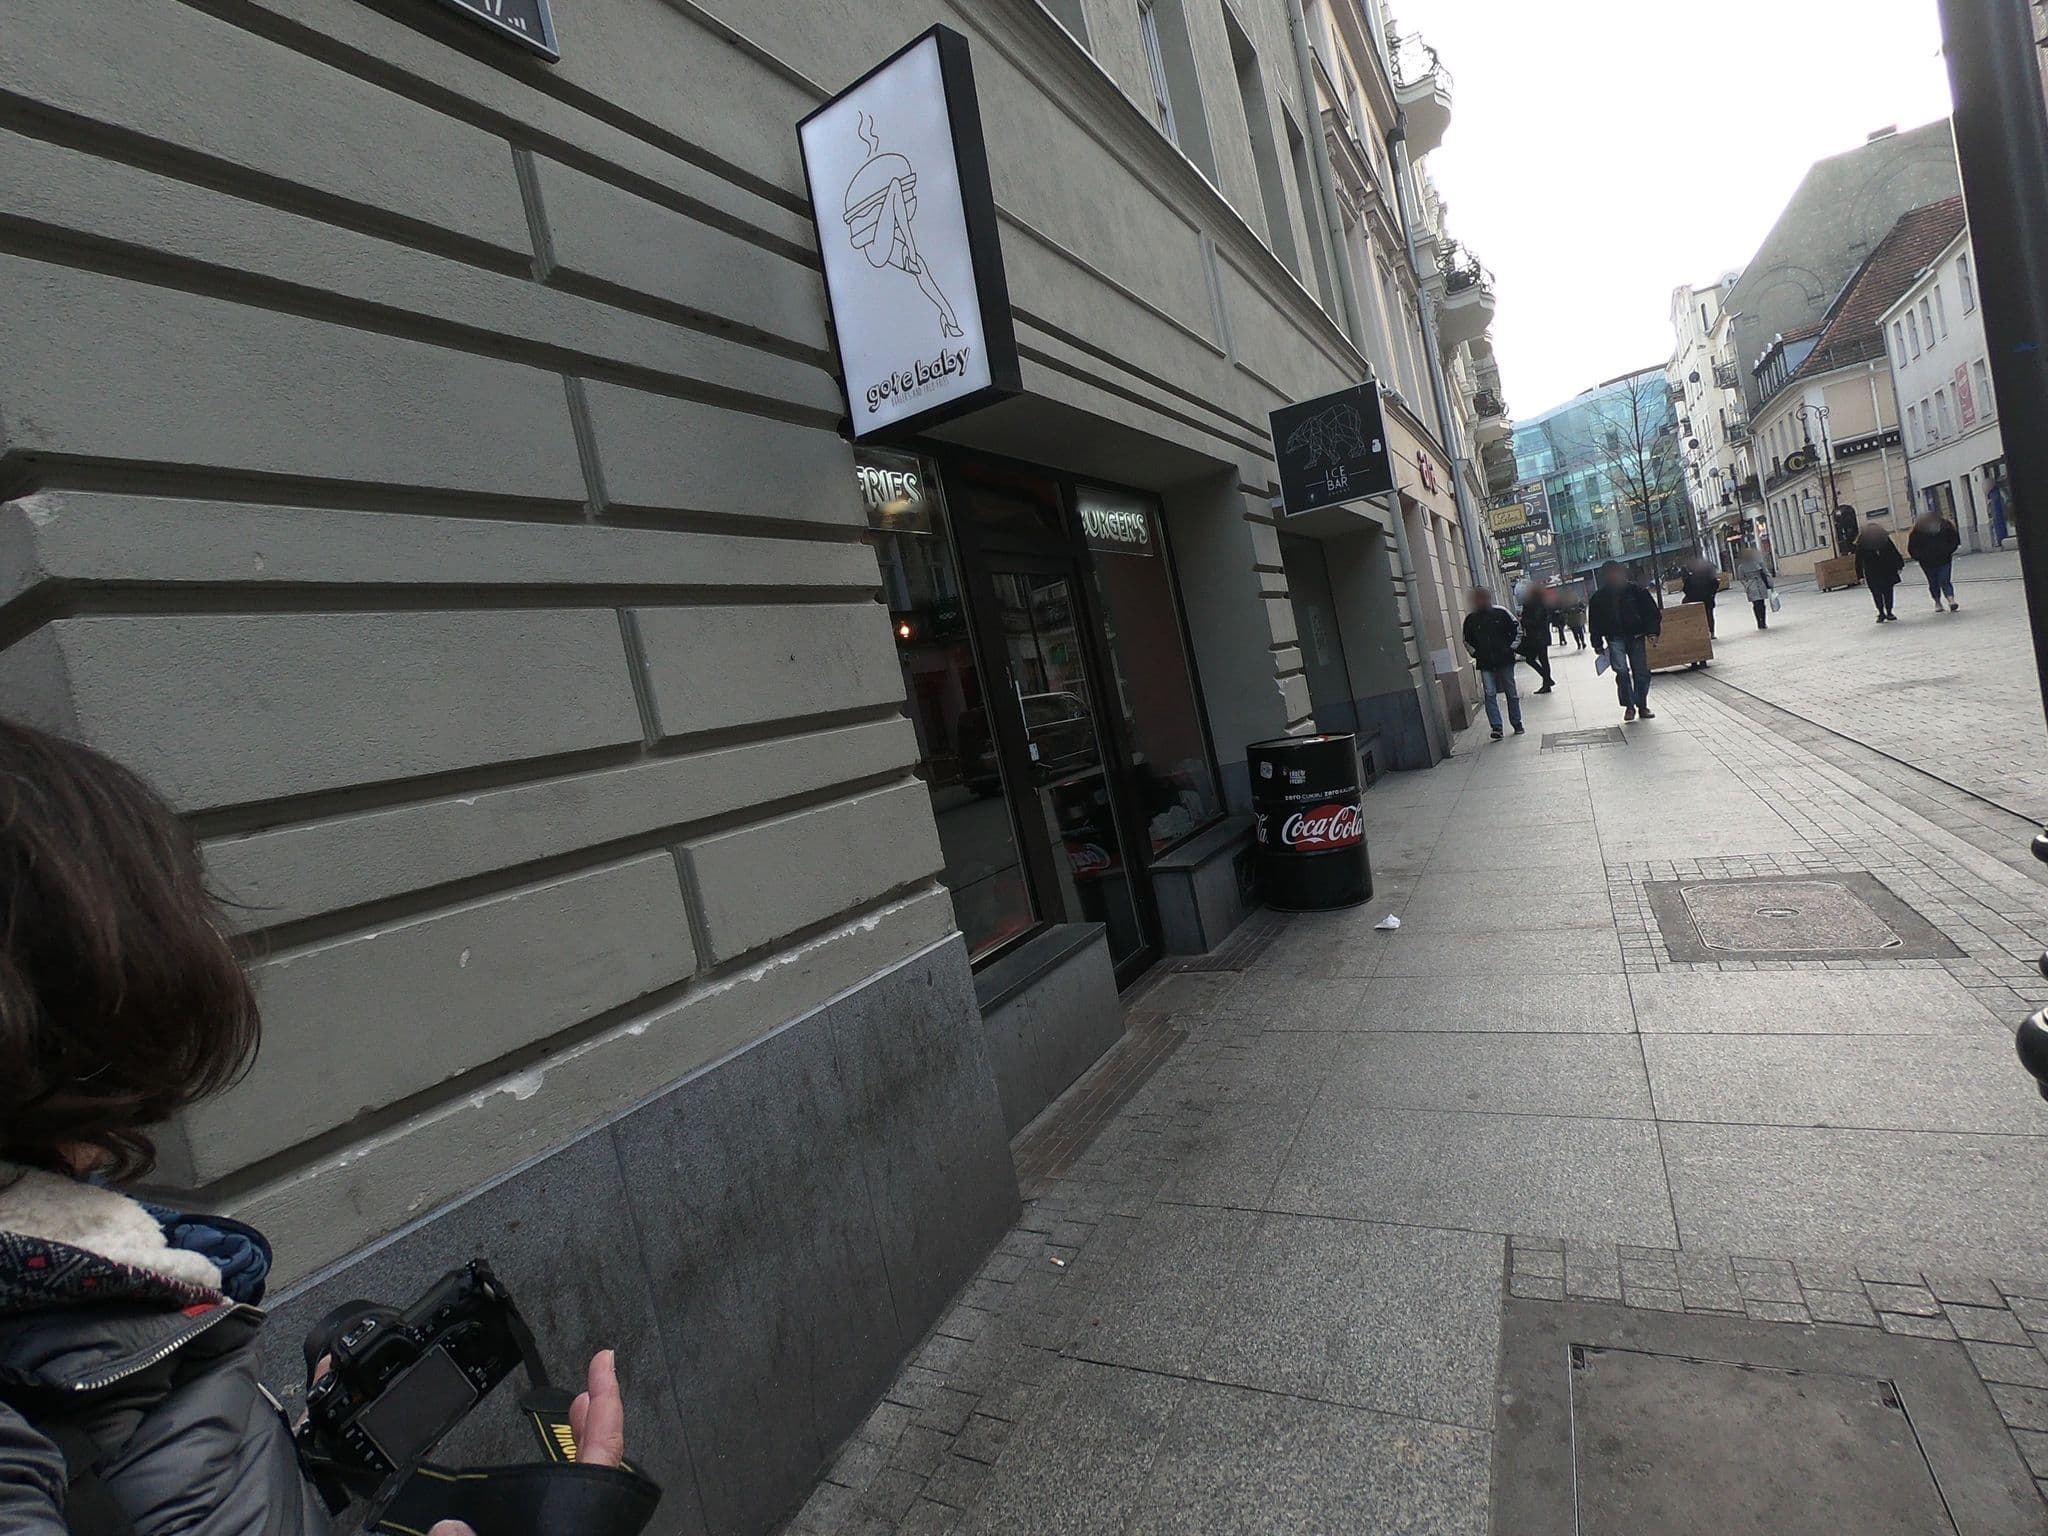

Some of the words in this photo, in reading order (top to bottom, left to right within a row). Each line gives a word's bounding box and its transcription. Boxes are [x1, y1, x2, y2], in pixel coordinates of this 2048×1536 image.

[915, 347, 970, 386] baby
[1325, 465, 1345, 479] ICE
[1327, 477, 1349, 491] BAR
